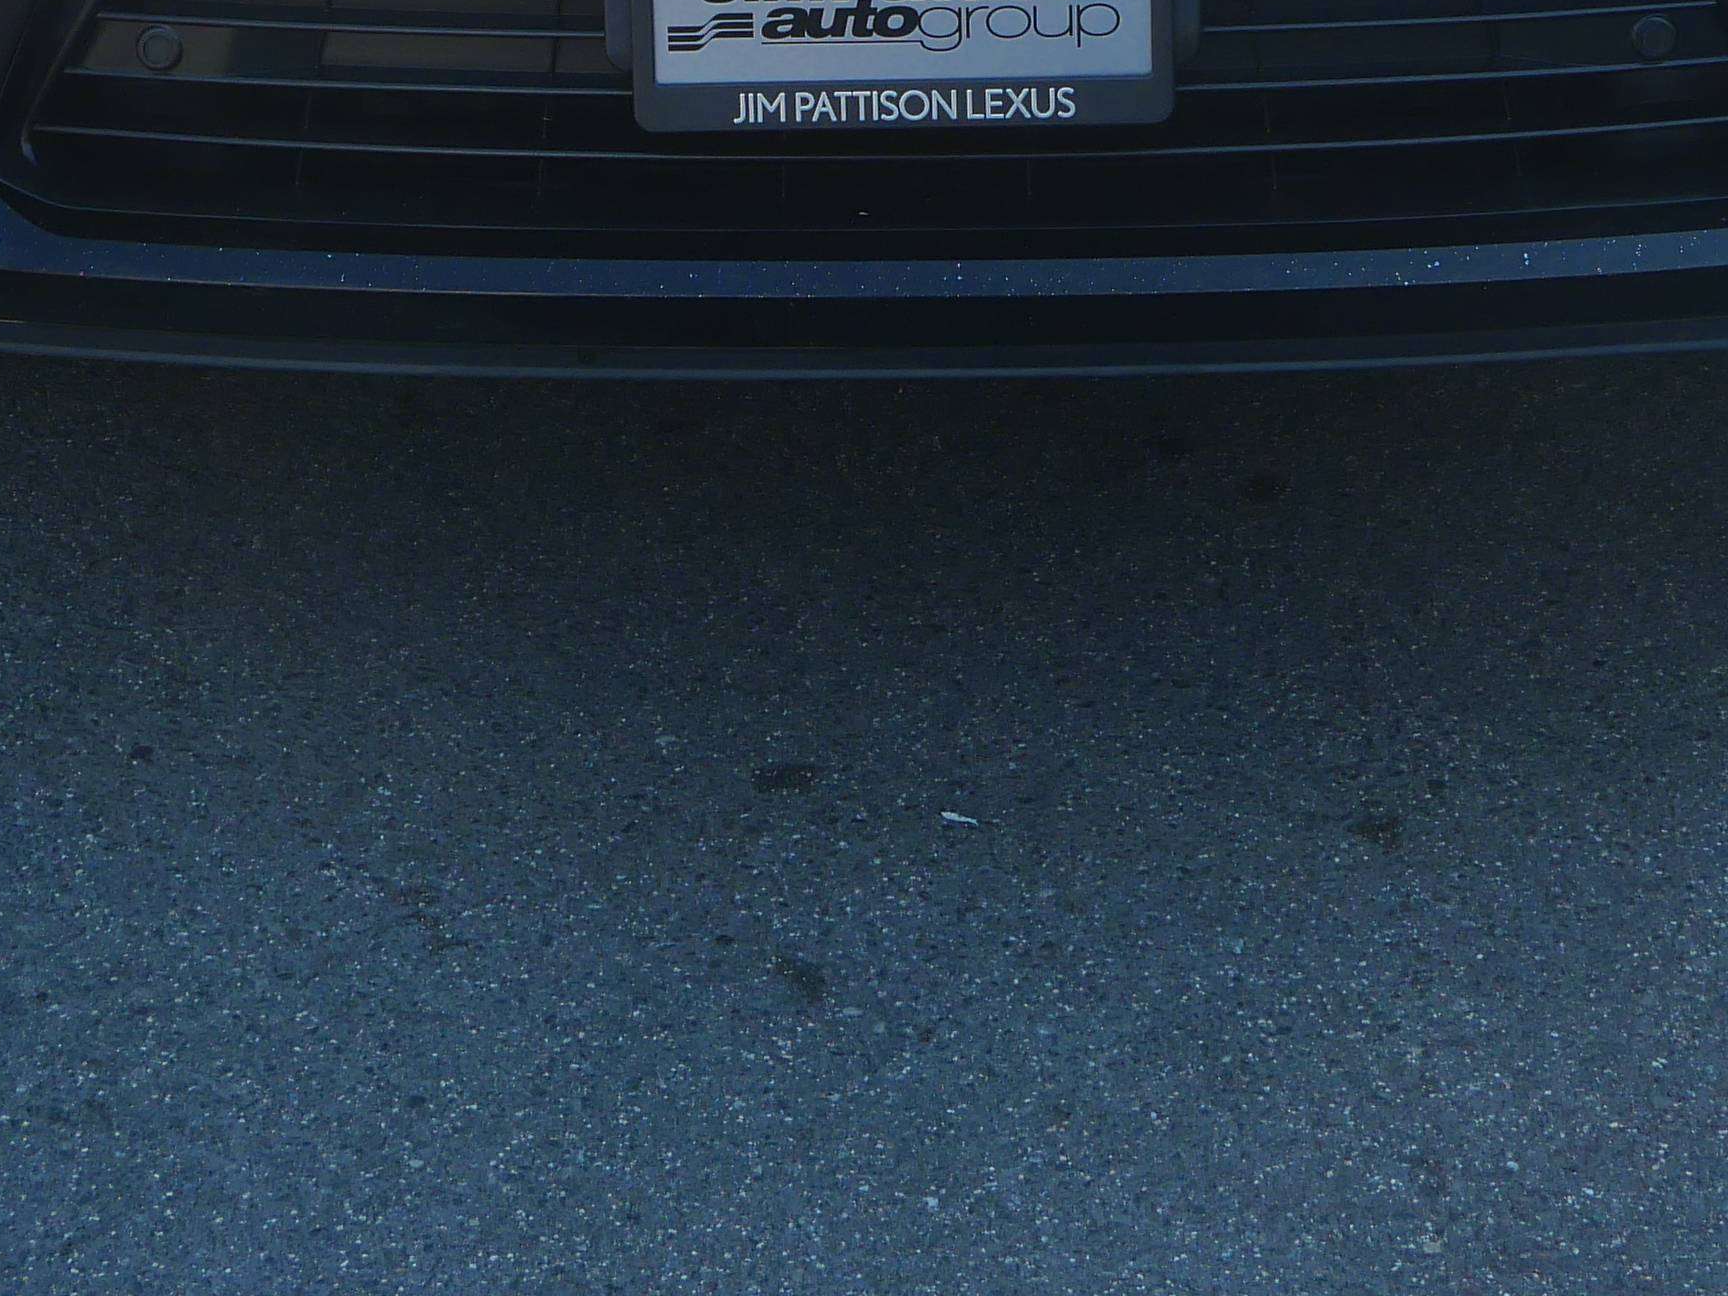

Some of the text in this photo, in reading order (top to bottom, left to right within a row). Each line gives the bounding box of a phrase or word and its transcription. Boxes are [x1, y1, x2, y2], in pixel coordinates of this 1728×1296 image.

[733, 87, 1077, 125] JIM PATTISON LEXUS
